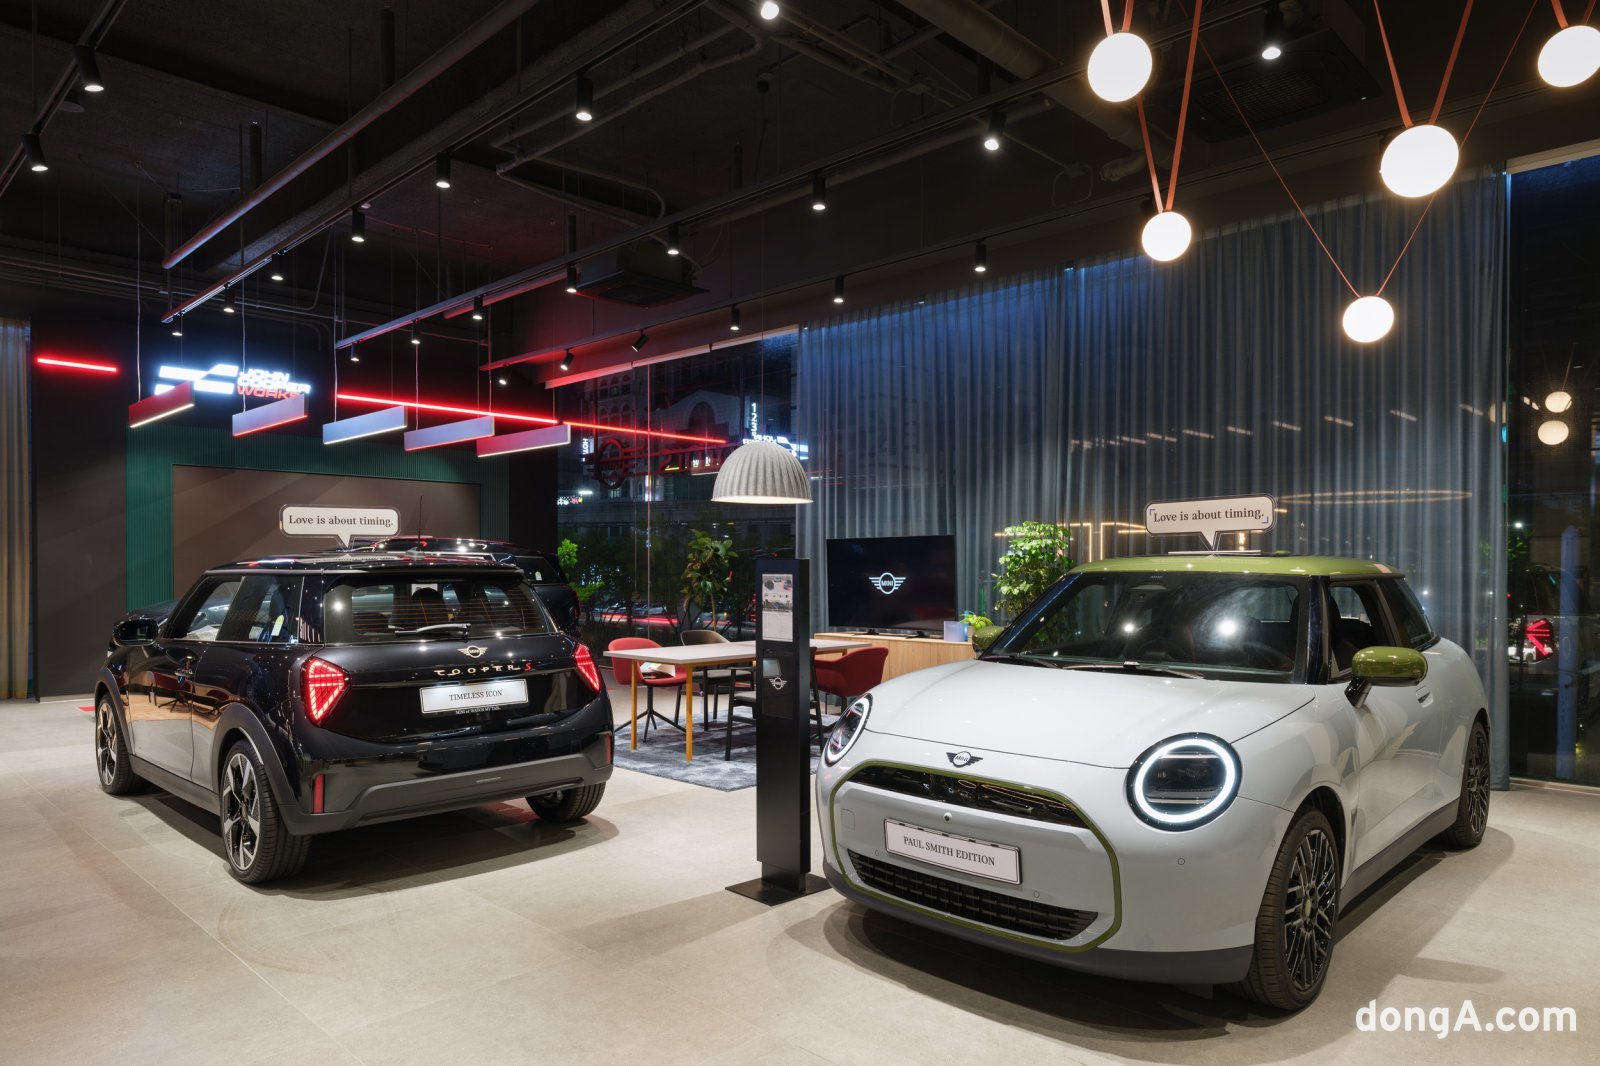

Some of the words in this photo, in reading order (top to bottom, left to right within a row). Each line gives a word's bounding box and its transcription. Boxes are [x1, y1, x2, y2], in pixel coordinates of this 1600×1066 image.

[289, 515, 314, 525] Love
[317, 515, 326, 525] is
[328, 515, 357, 525] about
[359, 516, 394, 528] timing.
[1154, 512, 1177, 523] Love
[1180, 511, 1189, 521] is
[1192, 510, 1222, 520] about
[1225, 507, 1264, 520] timing.
[433, 664, 521, 676] COOPER
[525, 662, 532, 672] S
[449, 691, 485, 701] TIMELESS
[485, 689, 503, 698] ICON
[903, 836, 924, 850] PAUL
[925, 842, 954, 857] SMITH
[956, 850, 995, 866] EDITION
